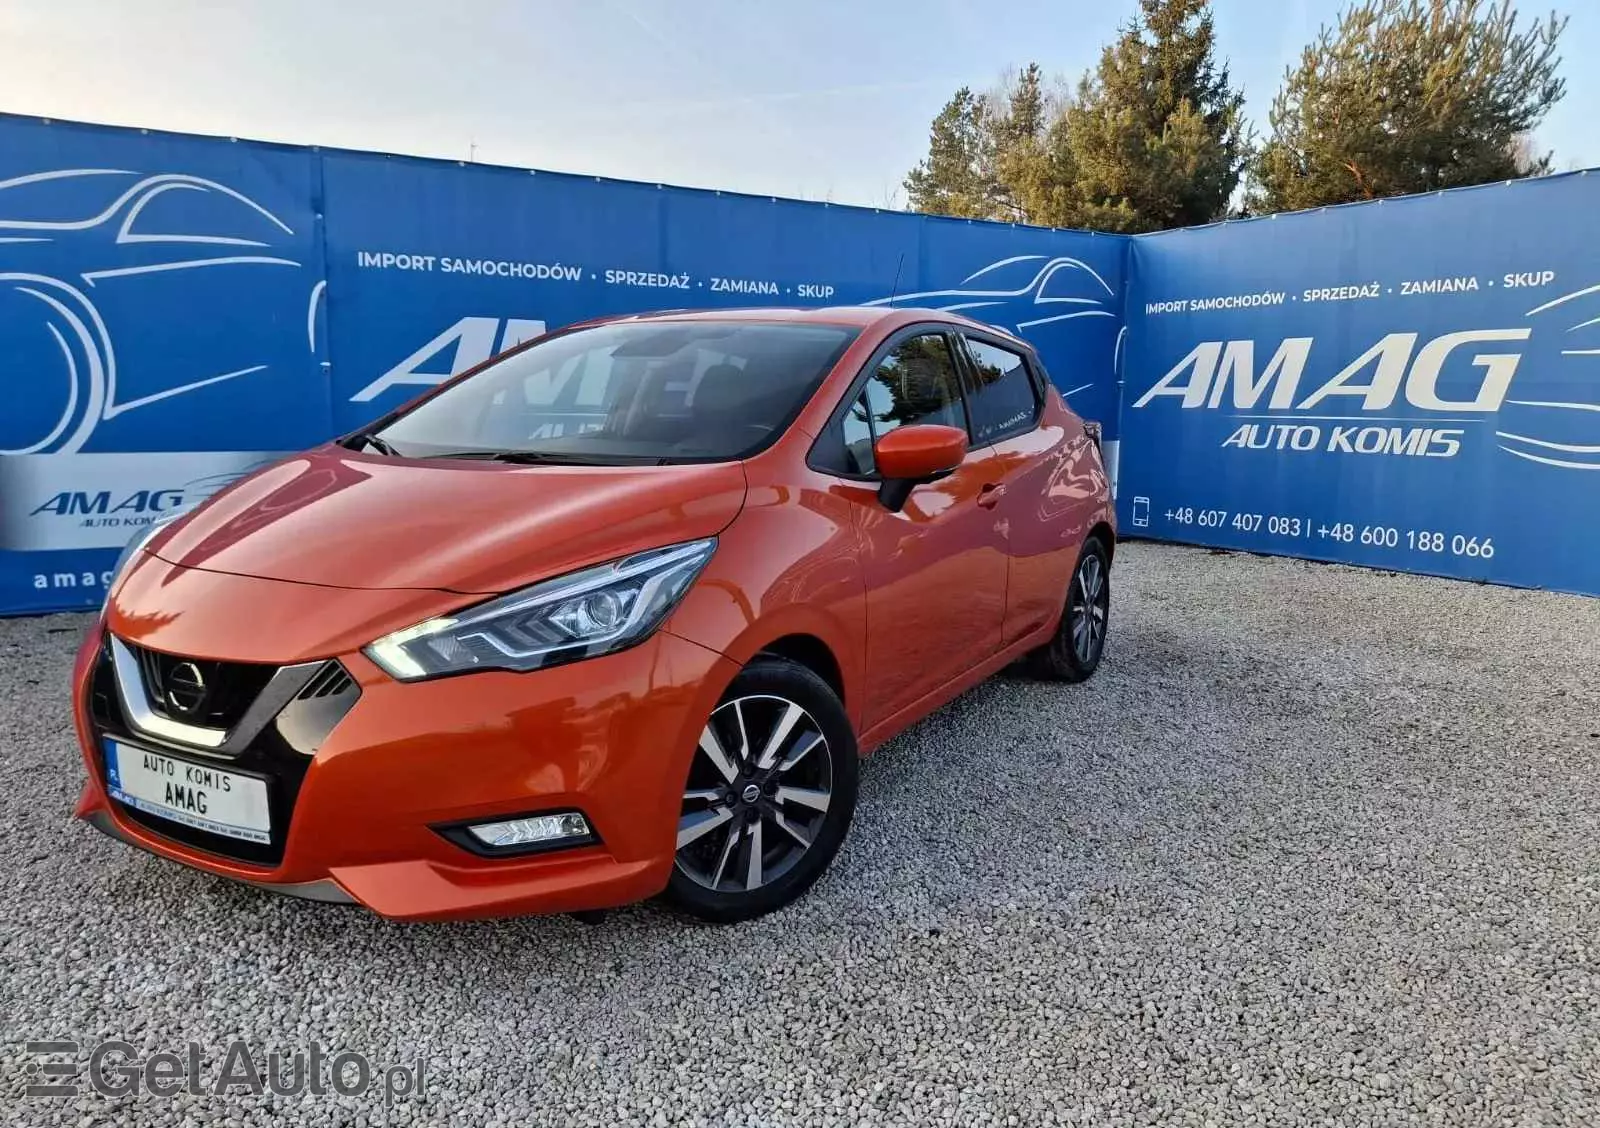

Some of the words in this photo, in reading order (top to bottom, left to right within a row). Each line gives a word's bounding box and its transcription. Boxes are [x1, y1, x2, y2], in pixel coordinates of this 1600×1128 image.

[357, 251, 436, 272] IMPORT
[440, 258, 582, 282] SAMOCHODÓW
[605, 269, 690, 290] SPRZEDAŻ
[710, 277, 780, 296] ZAMIANA
[797, 283, 834, 299] SKUP
[1145, 300, 1187, 316] IMPORT
[1190, 291, 1286, 312] SAMOCHODÓW
[1303, 283, 1381, 303] SPRZEDAŻ
[1400, 276, 1479, 296] ZAMIANA
[1503, 270, 1555, 289] SKUP
[1132, 327, 1532, 413] AMAG
[1221, 423, 1321, 451] AUTO
[1326, 426, 1465, 458] KOMIS
[29, 489, 185, 516] AMAG
[79, 517, 120, 528] AUTO
[123, 516, 156, 527] KOM
[1163, 507, 1194, 525] +48
[1197, 510, 1228, 528] 607
[1231, 513, 1262, 532] 407
[1268, 516, 1302, 537] 083
[1317, 522, 1354, 543] +48
[1360, 525, 1399, 548] 600
[1406, 530, 1445, 553] 188
[1451, 534, 1495, 559] 066
[143, 753, 175, 777] AUTO
[185, 765, 232, 793] KOMIS
[165, 782, 208, 815] AMAG
